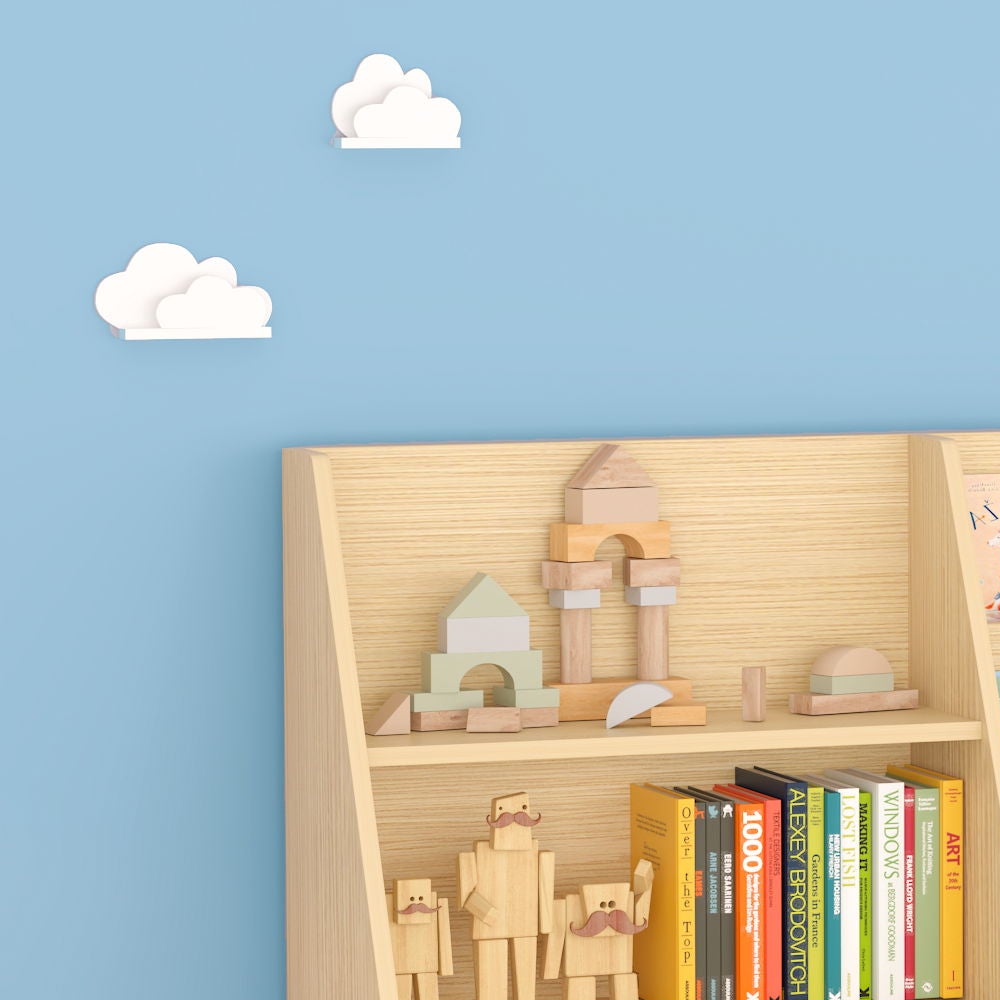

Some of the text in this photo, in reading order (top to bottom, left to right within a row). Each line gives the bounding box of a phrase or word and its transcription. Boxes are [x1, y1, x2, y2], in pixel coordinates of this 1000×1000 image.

[742, 810, 763, 873] 1000
[773, 812, 781, 877] TEXTILE DESIGNERS
[789, 788, 807, 863] ALEXEY
[842, 795, 857, 888] LOST FISH
[859, 803, 868, 872] MAKING IT
[883, 790, 900, 880] WINDOWS
[926, 821, 934, 833] The
[926, 833, 934, 844] Art
[946, 832, 961, 866] ART
[709, 851, 718, 914] ARNE JACOBSEN
[724, 853, 733, 914] EERO SAARINEN
[833, 834, 841, 915] NEW URBAN HOUSING
[905, 855, 914, 933] FRANK LLOYD WRIGHT
[926, 851, 934, 876] Knitting
[789, 869, 807, 995] BRODOVITCH
[811, 854, 822, 948] Gardens in France
[887, 889, 897, 924] BERGDORF
[887, 925, 896, 962] GOODMAN
